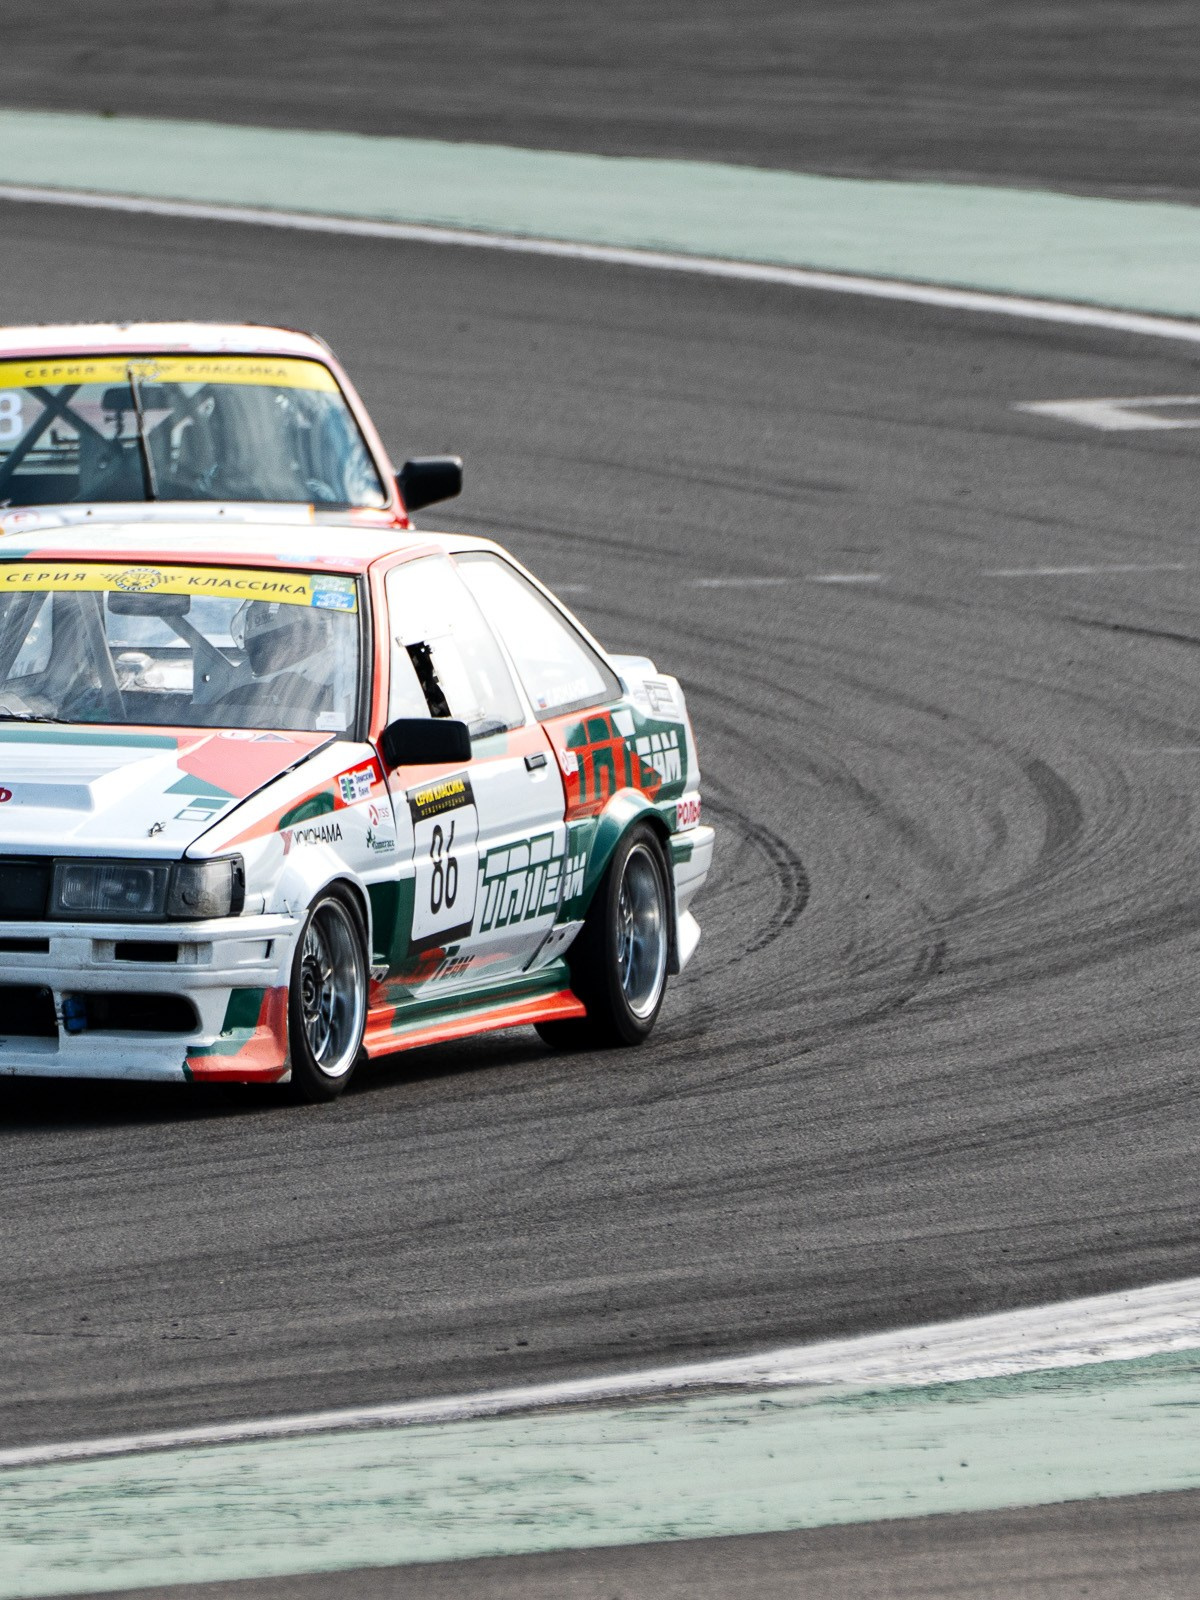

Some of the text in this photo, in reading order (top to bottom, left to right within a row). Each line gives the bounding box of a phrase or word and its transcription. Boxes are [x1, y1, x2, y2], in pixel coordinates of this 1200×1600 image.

[6, 573, 87, 582] СЕРИЯ
[188, 577, 306, 595] КЛАССИКА
[415, 778, 465, 807] СЕРИЯ КЛАССИКА
[294, 823, 343, 846] YOKOHAMA
[430, 820, 458, 915] 86
